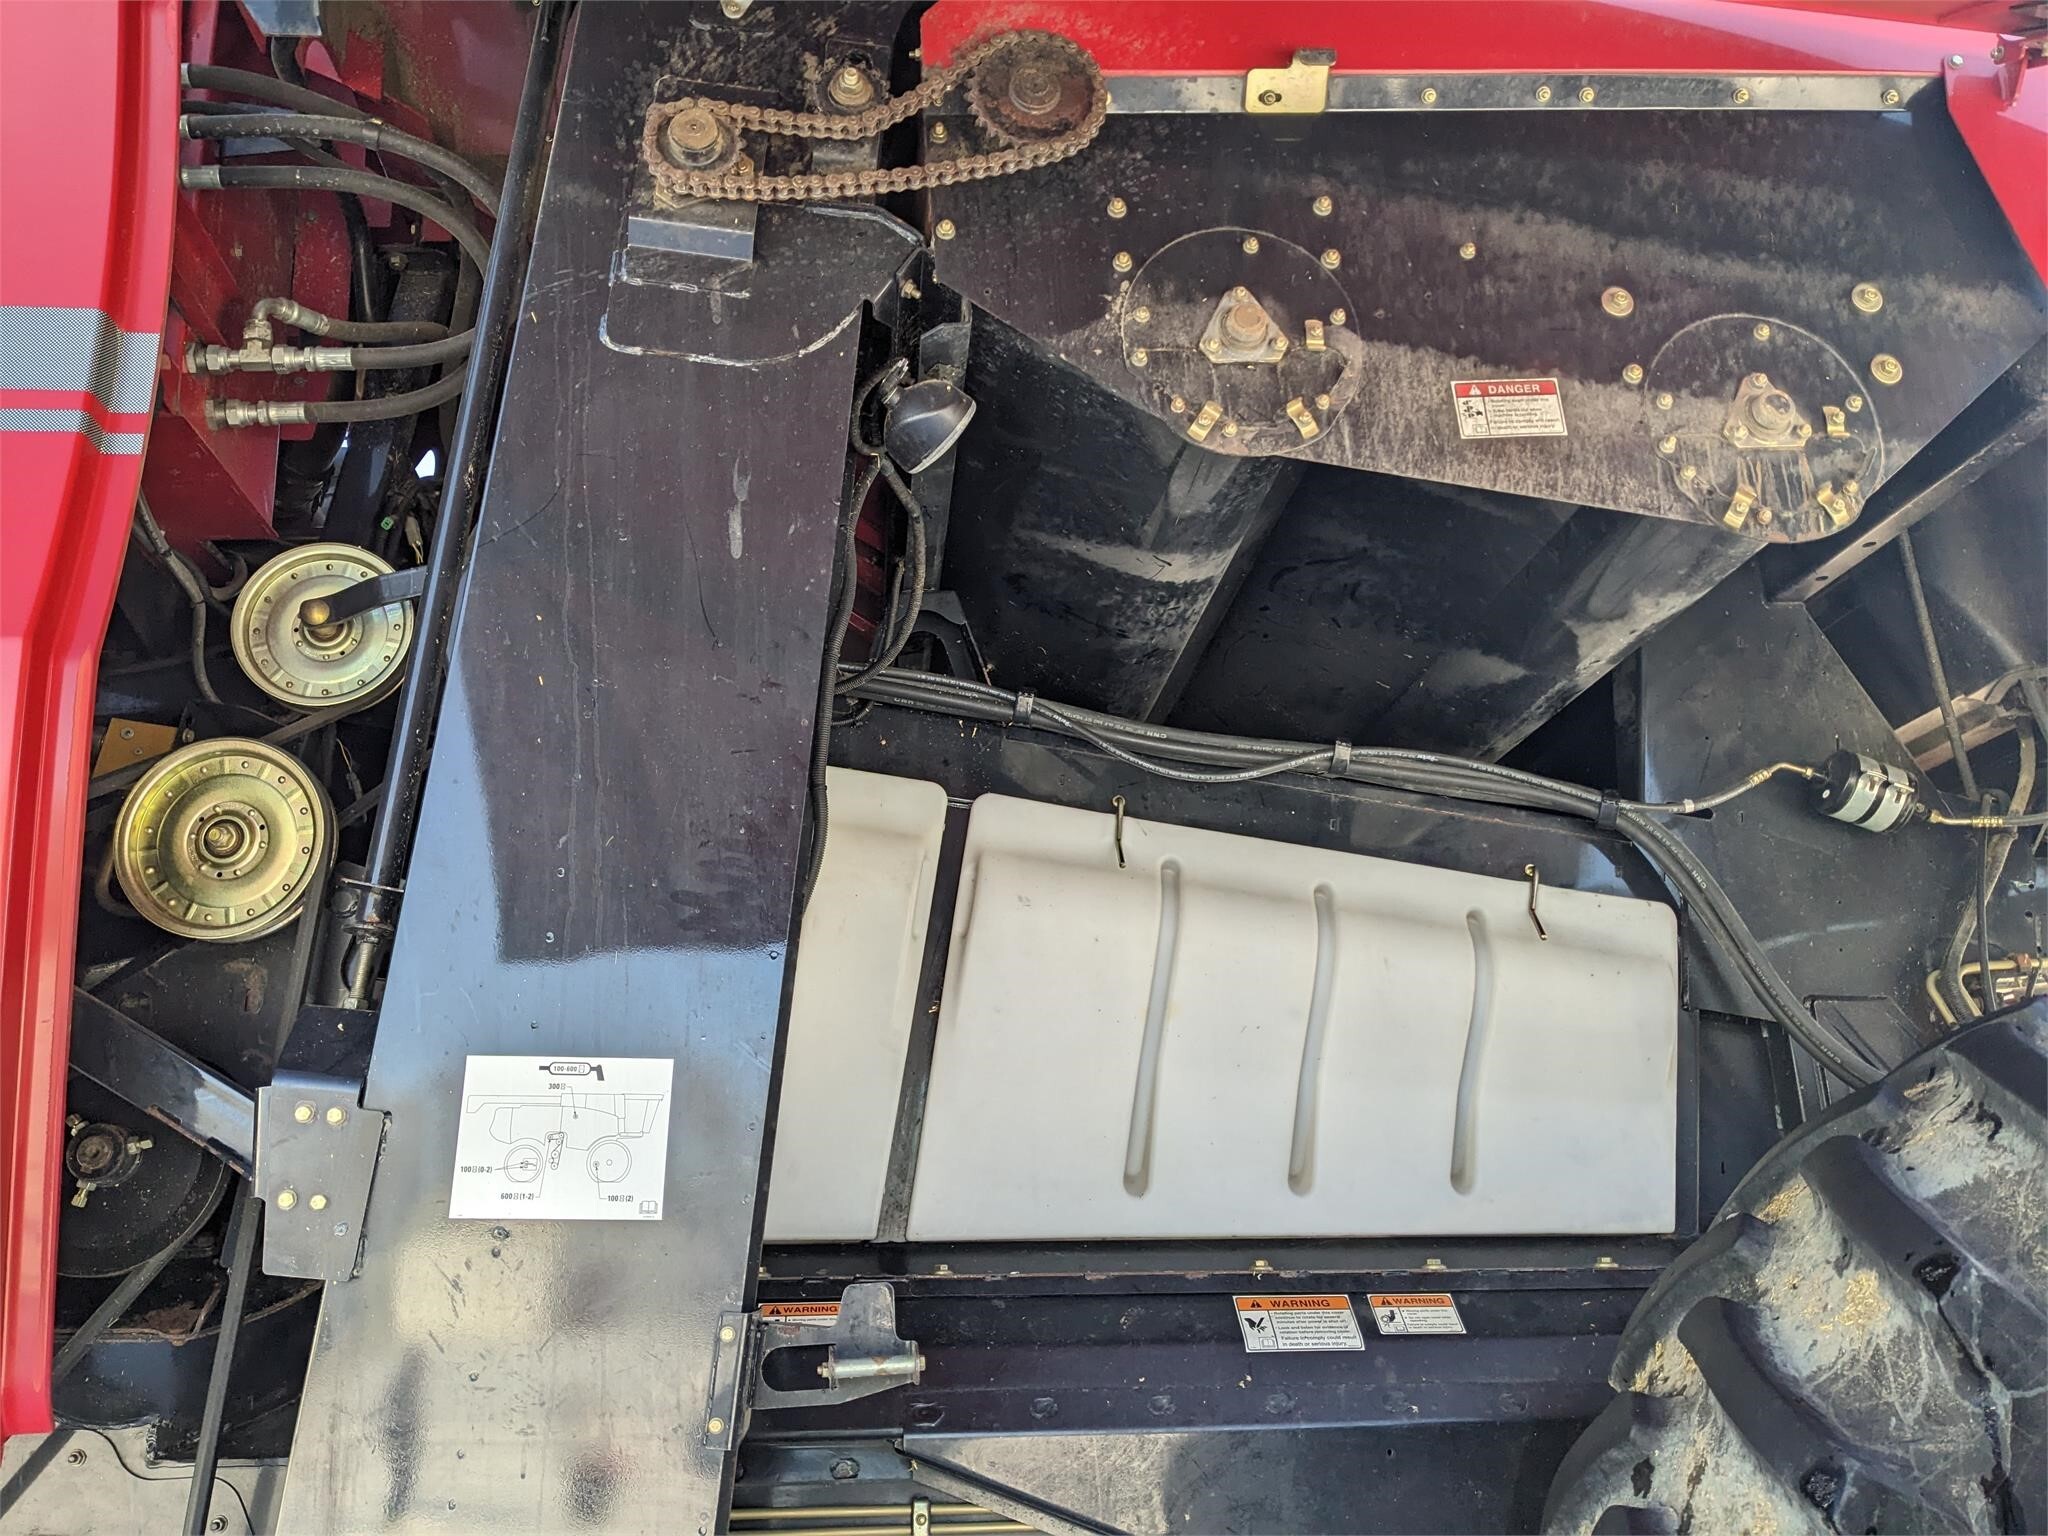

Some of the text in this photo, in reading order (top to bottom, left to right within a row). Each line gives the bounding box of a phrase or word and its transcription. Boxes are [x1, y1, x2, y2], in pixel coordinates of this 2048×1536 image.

[1488, 384, 1541, 394] DANGER
[1146, 731, 1168, 739] CNH
[1691, 870, 1707, 889] CNH
[1270, 1299, 1330, 1308] WARNING
